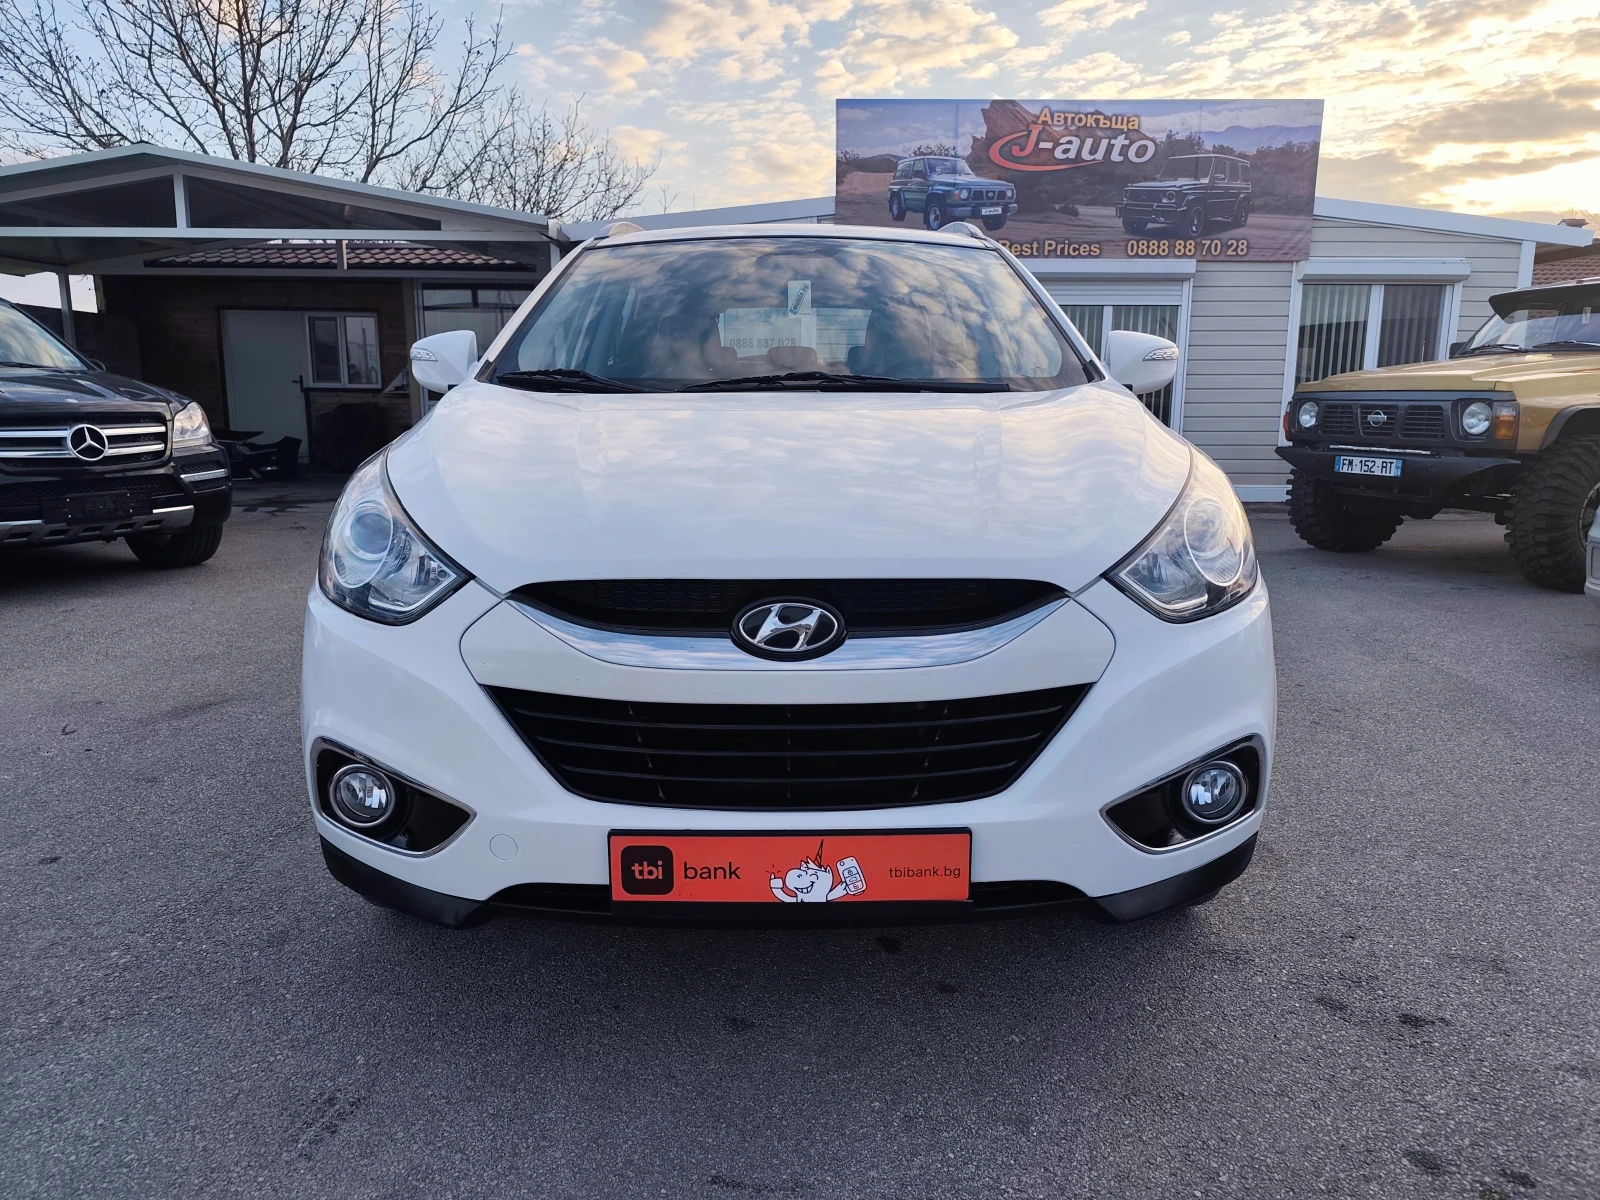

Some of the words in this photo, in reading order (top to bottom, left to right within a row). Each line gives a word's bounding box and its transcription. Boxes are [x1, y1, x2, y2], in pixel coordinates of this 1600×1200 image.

[1037, 108, 1139, 131] Автокъща
[1010, 124, 1156, 163] J-auto
[1043, 240, 1101, 256] Prices
[1127, 240, 1169, 256] 0888
[1174, 240, 1196, 256] 88
[1201, 240, 1221, 256] 70
[1226, 240, 1248, 256] 28
[1341, 458, 1394, 475] FM-152-RT
[631, 860, 663, 880] tbi
[683, 861, 742, 880] bank
[889, 866, 961, 879] tbibank.bg
